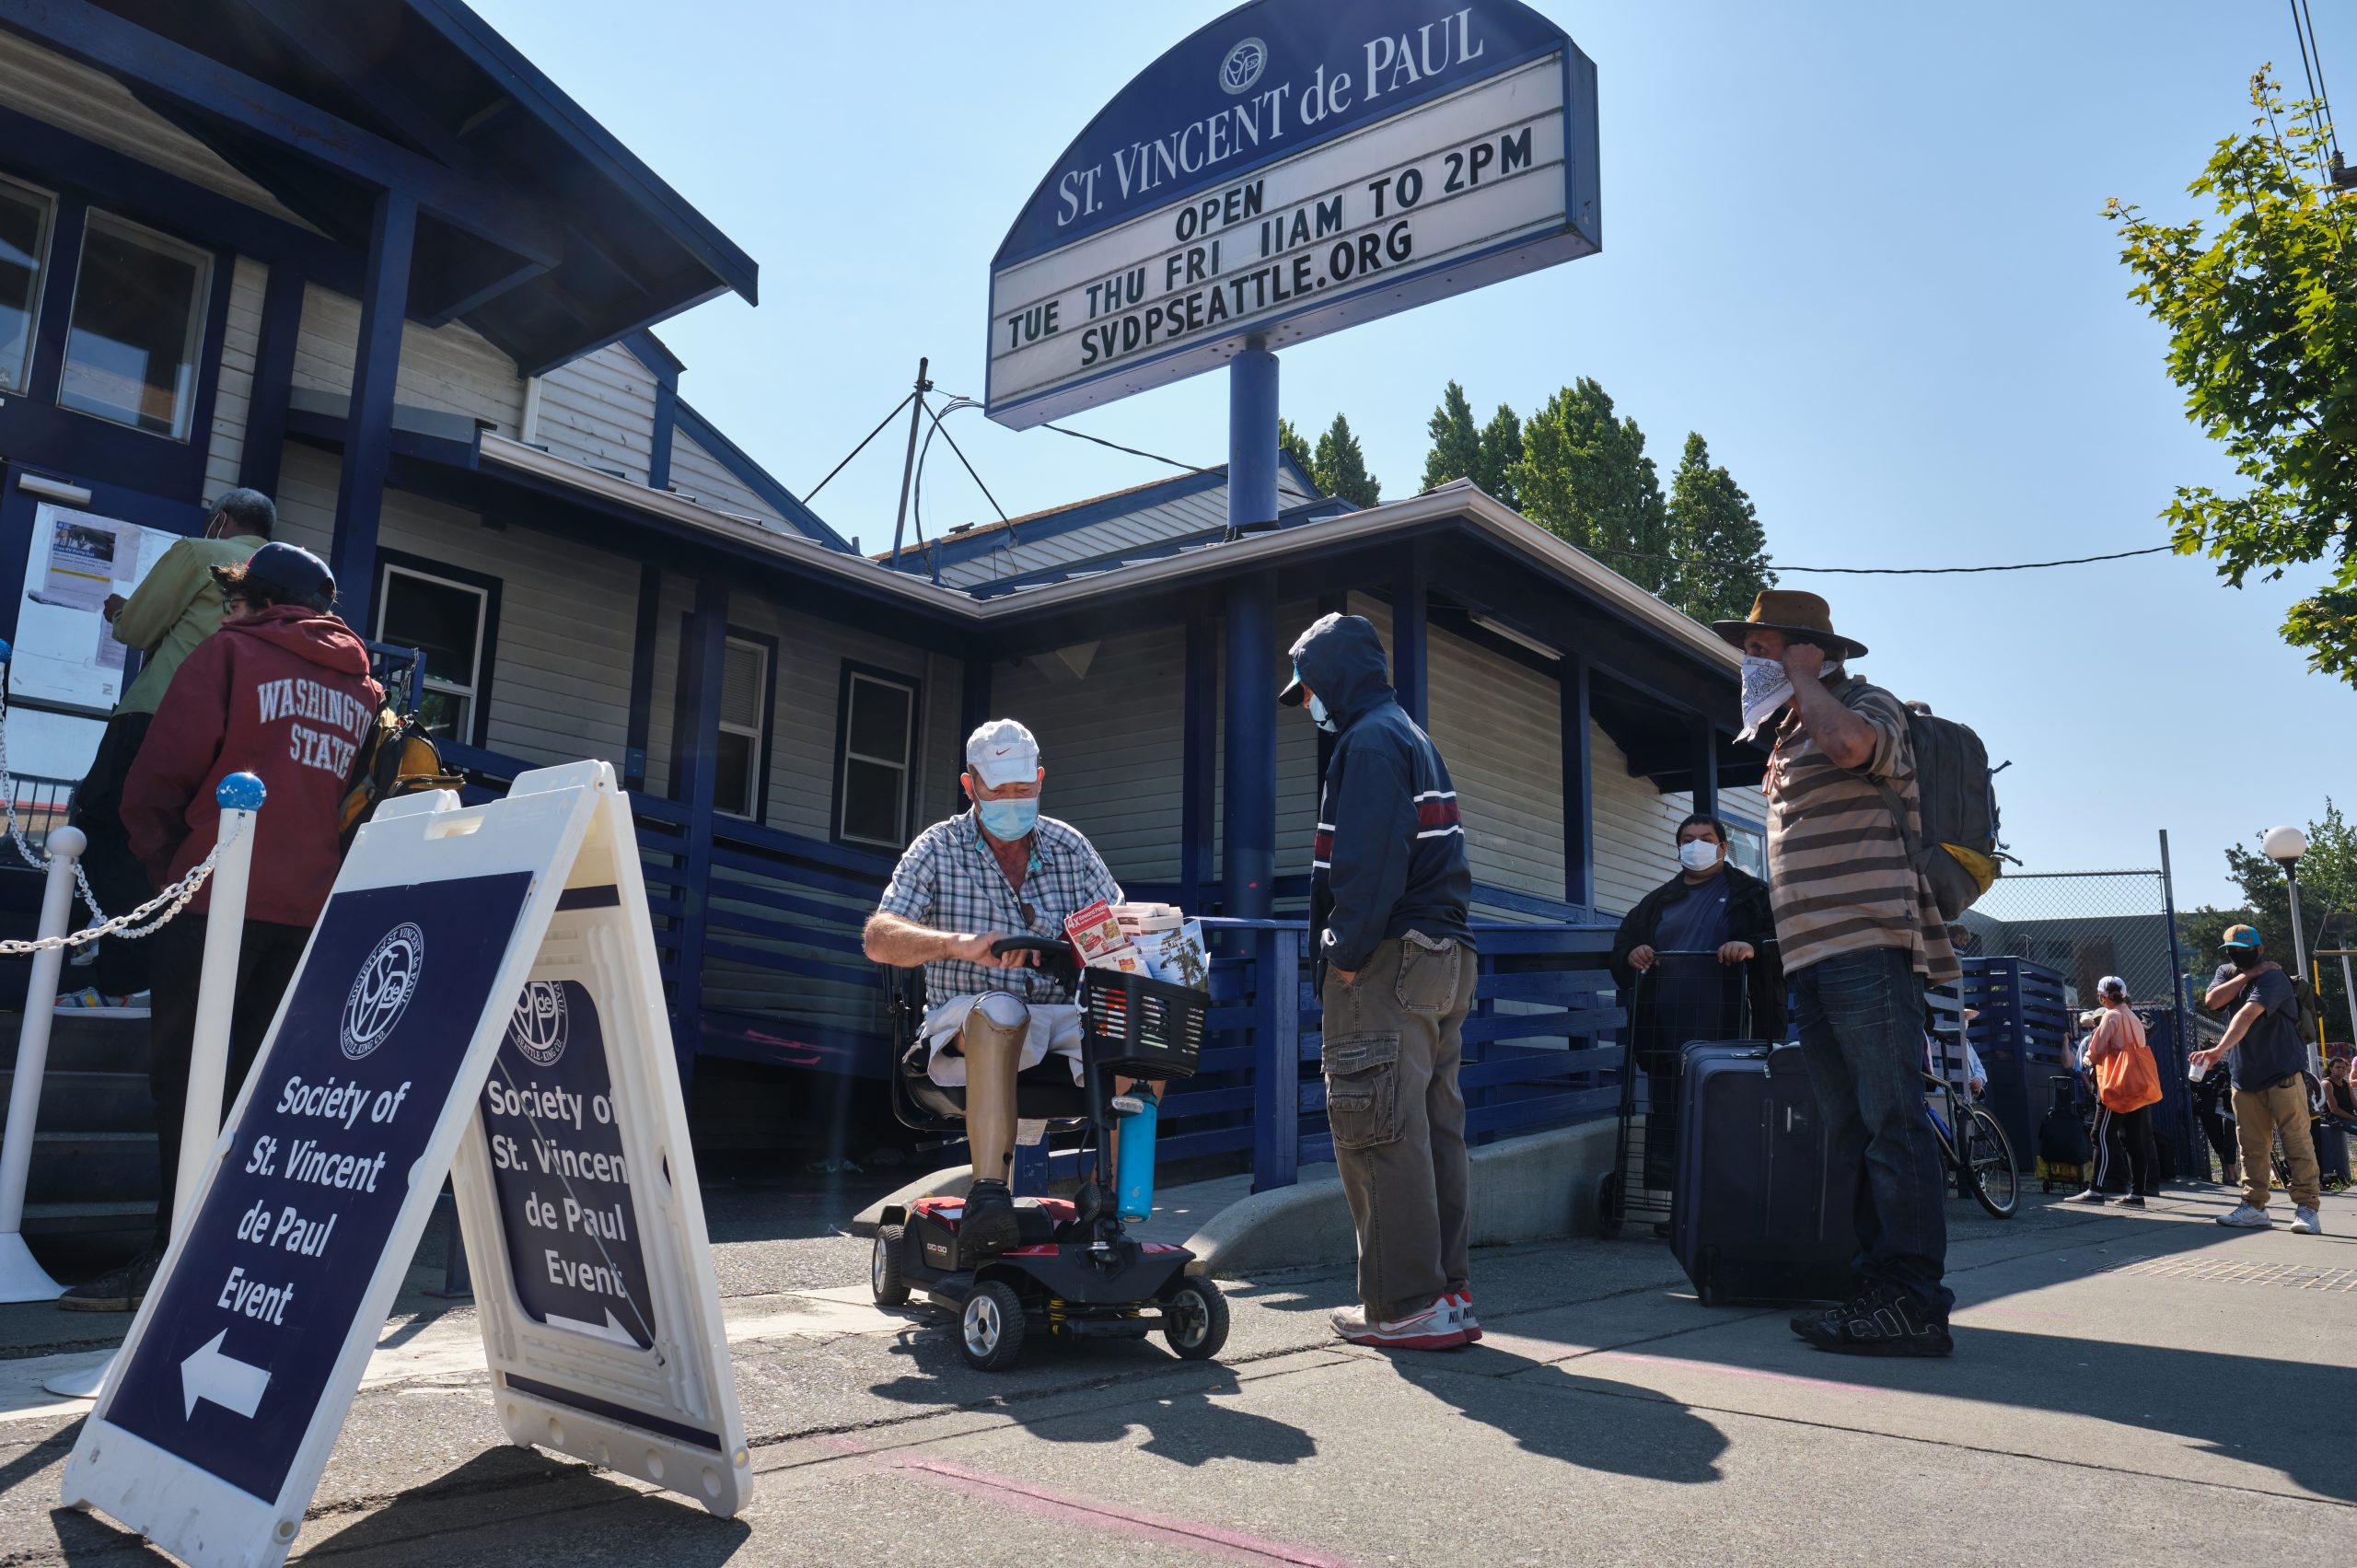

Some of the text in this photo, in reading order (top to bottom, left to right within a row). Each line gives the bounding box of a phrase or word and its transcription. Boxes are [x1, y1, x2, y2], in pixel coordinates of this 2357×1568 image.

[1058, 7, 1483, 226] ST. VINCENT de PAUL
[1008, 127, 1532, 348] TUE THU FRI 11AM TO 2PM
[1176, 180, 1264, 242] OPEN
[1081, 220, 1412, 366] SVDPSEATTLE.ORG
[257, 678, 372, 750] WASHINGTO
[290, 722, 356, 780] STATE
[400, 927, 421, 955] VINCENT
[412, 956, 420, 969] de
[348, 952, 378, 1007] SOCIETY
[399, 971, 417, 1006] PAUL
[276, 1075, 412, 1130] Society of
[487, 1080, 582, 1130] Society
[245, 1135, 386, 1193] St. Vincent
[492, 1134, 630, 1184] St. Vincen
[237, 1199, 338, 1258] de Paul
[525, 1191, 626, 1241] de Paul
[216, 1266, 294, 1326] Event
[544, 1249, 626, 1298] Event
